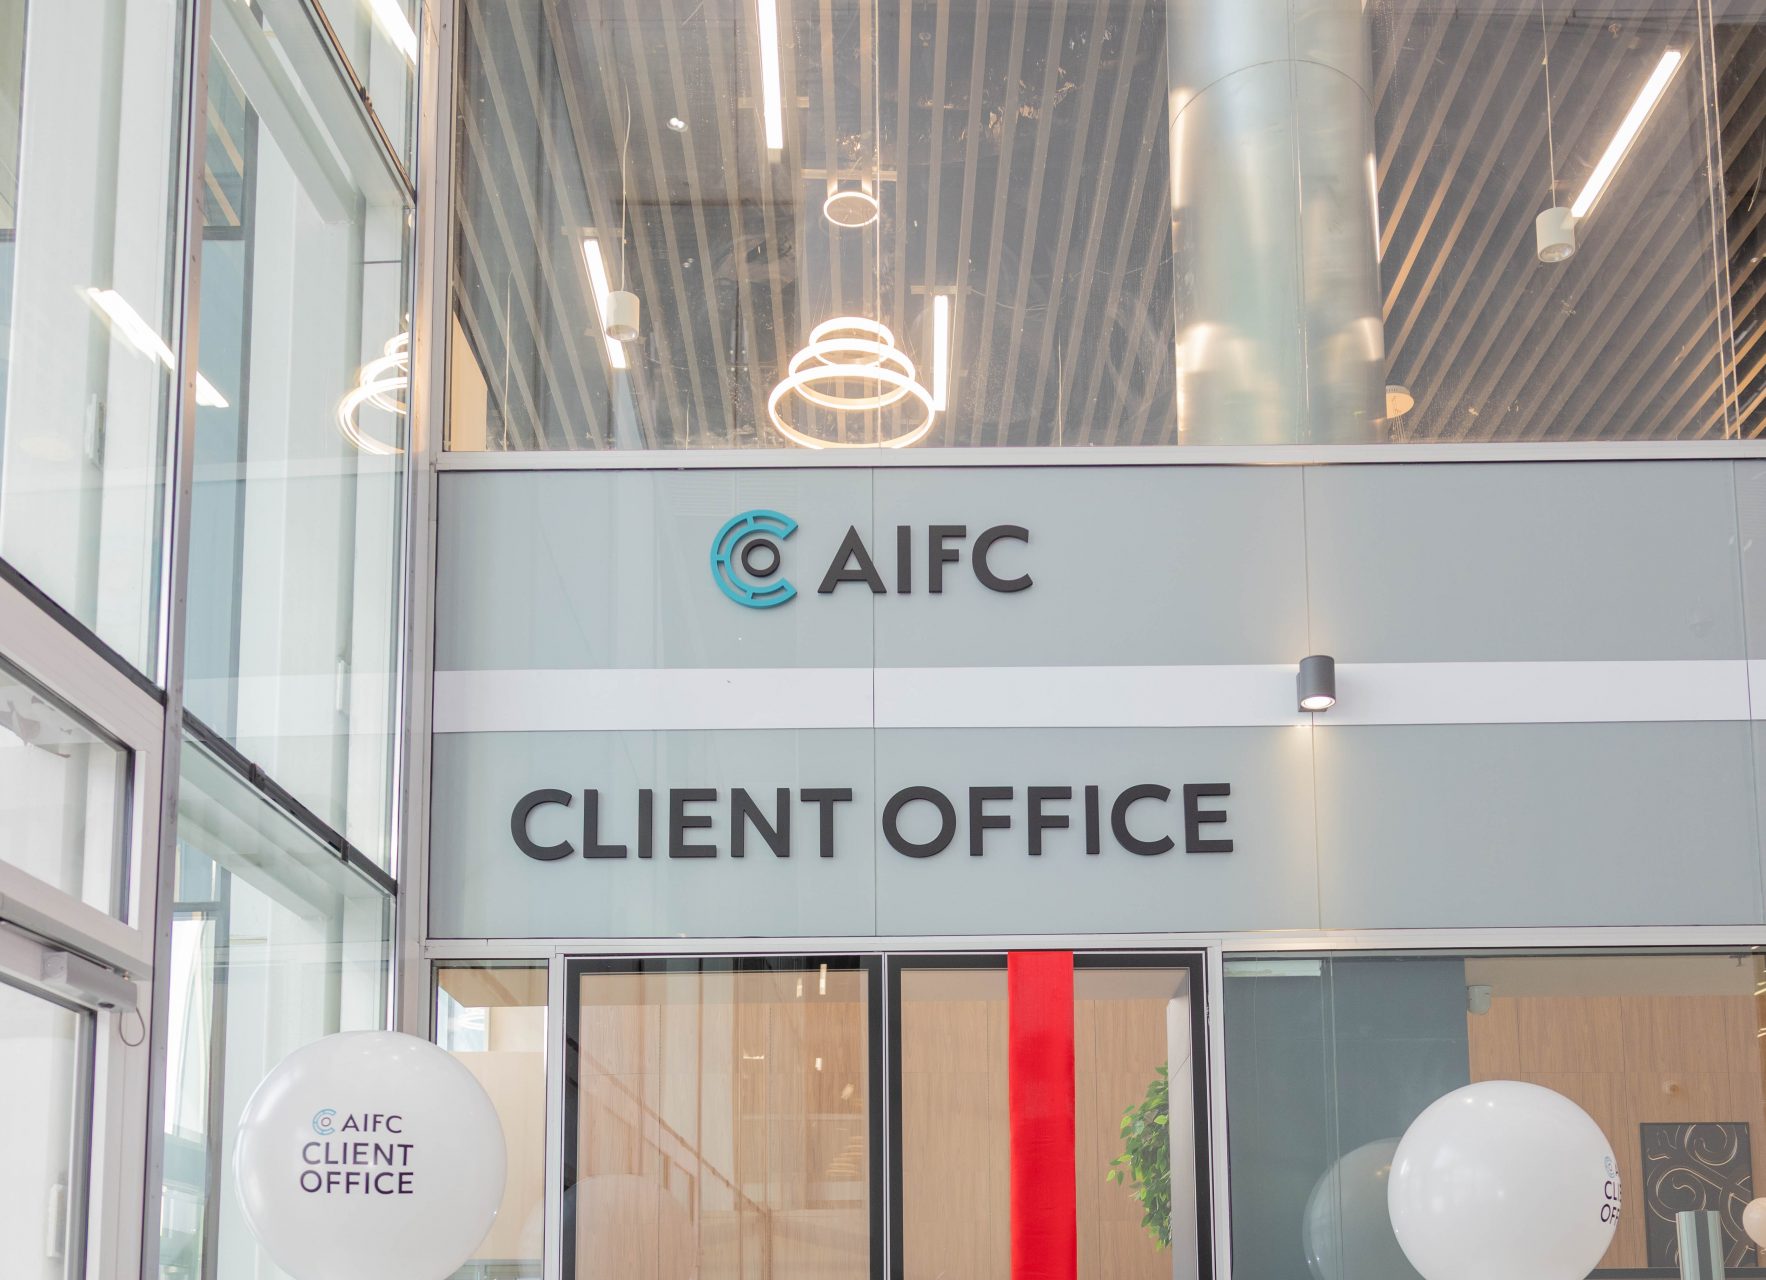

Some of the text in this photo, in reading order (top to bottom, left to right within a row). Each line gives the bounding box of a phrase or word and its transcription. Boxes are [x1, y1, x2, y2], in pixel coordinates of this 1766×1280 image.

[817, 523, 1034, 595] AIFC
[510, 782, 1235, 861] CLIENT OFFICE
[341, 1113, 403, 1134] AIFC
[302, 1141, 414, 1166] CLIENT
[299, 1169, 414, 1195] OFFICE
